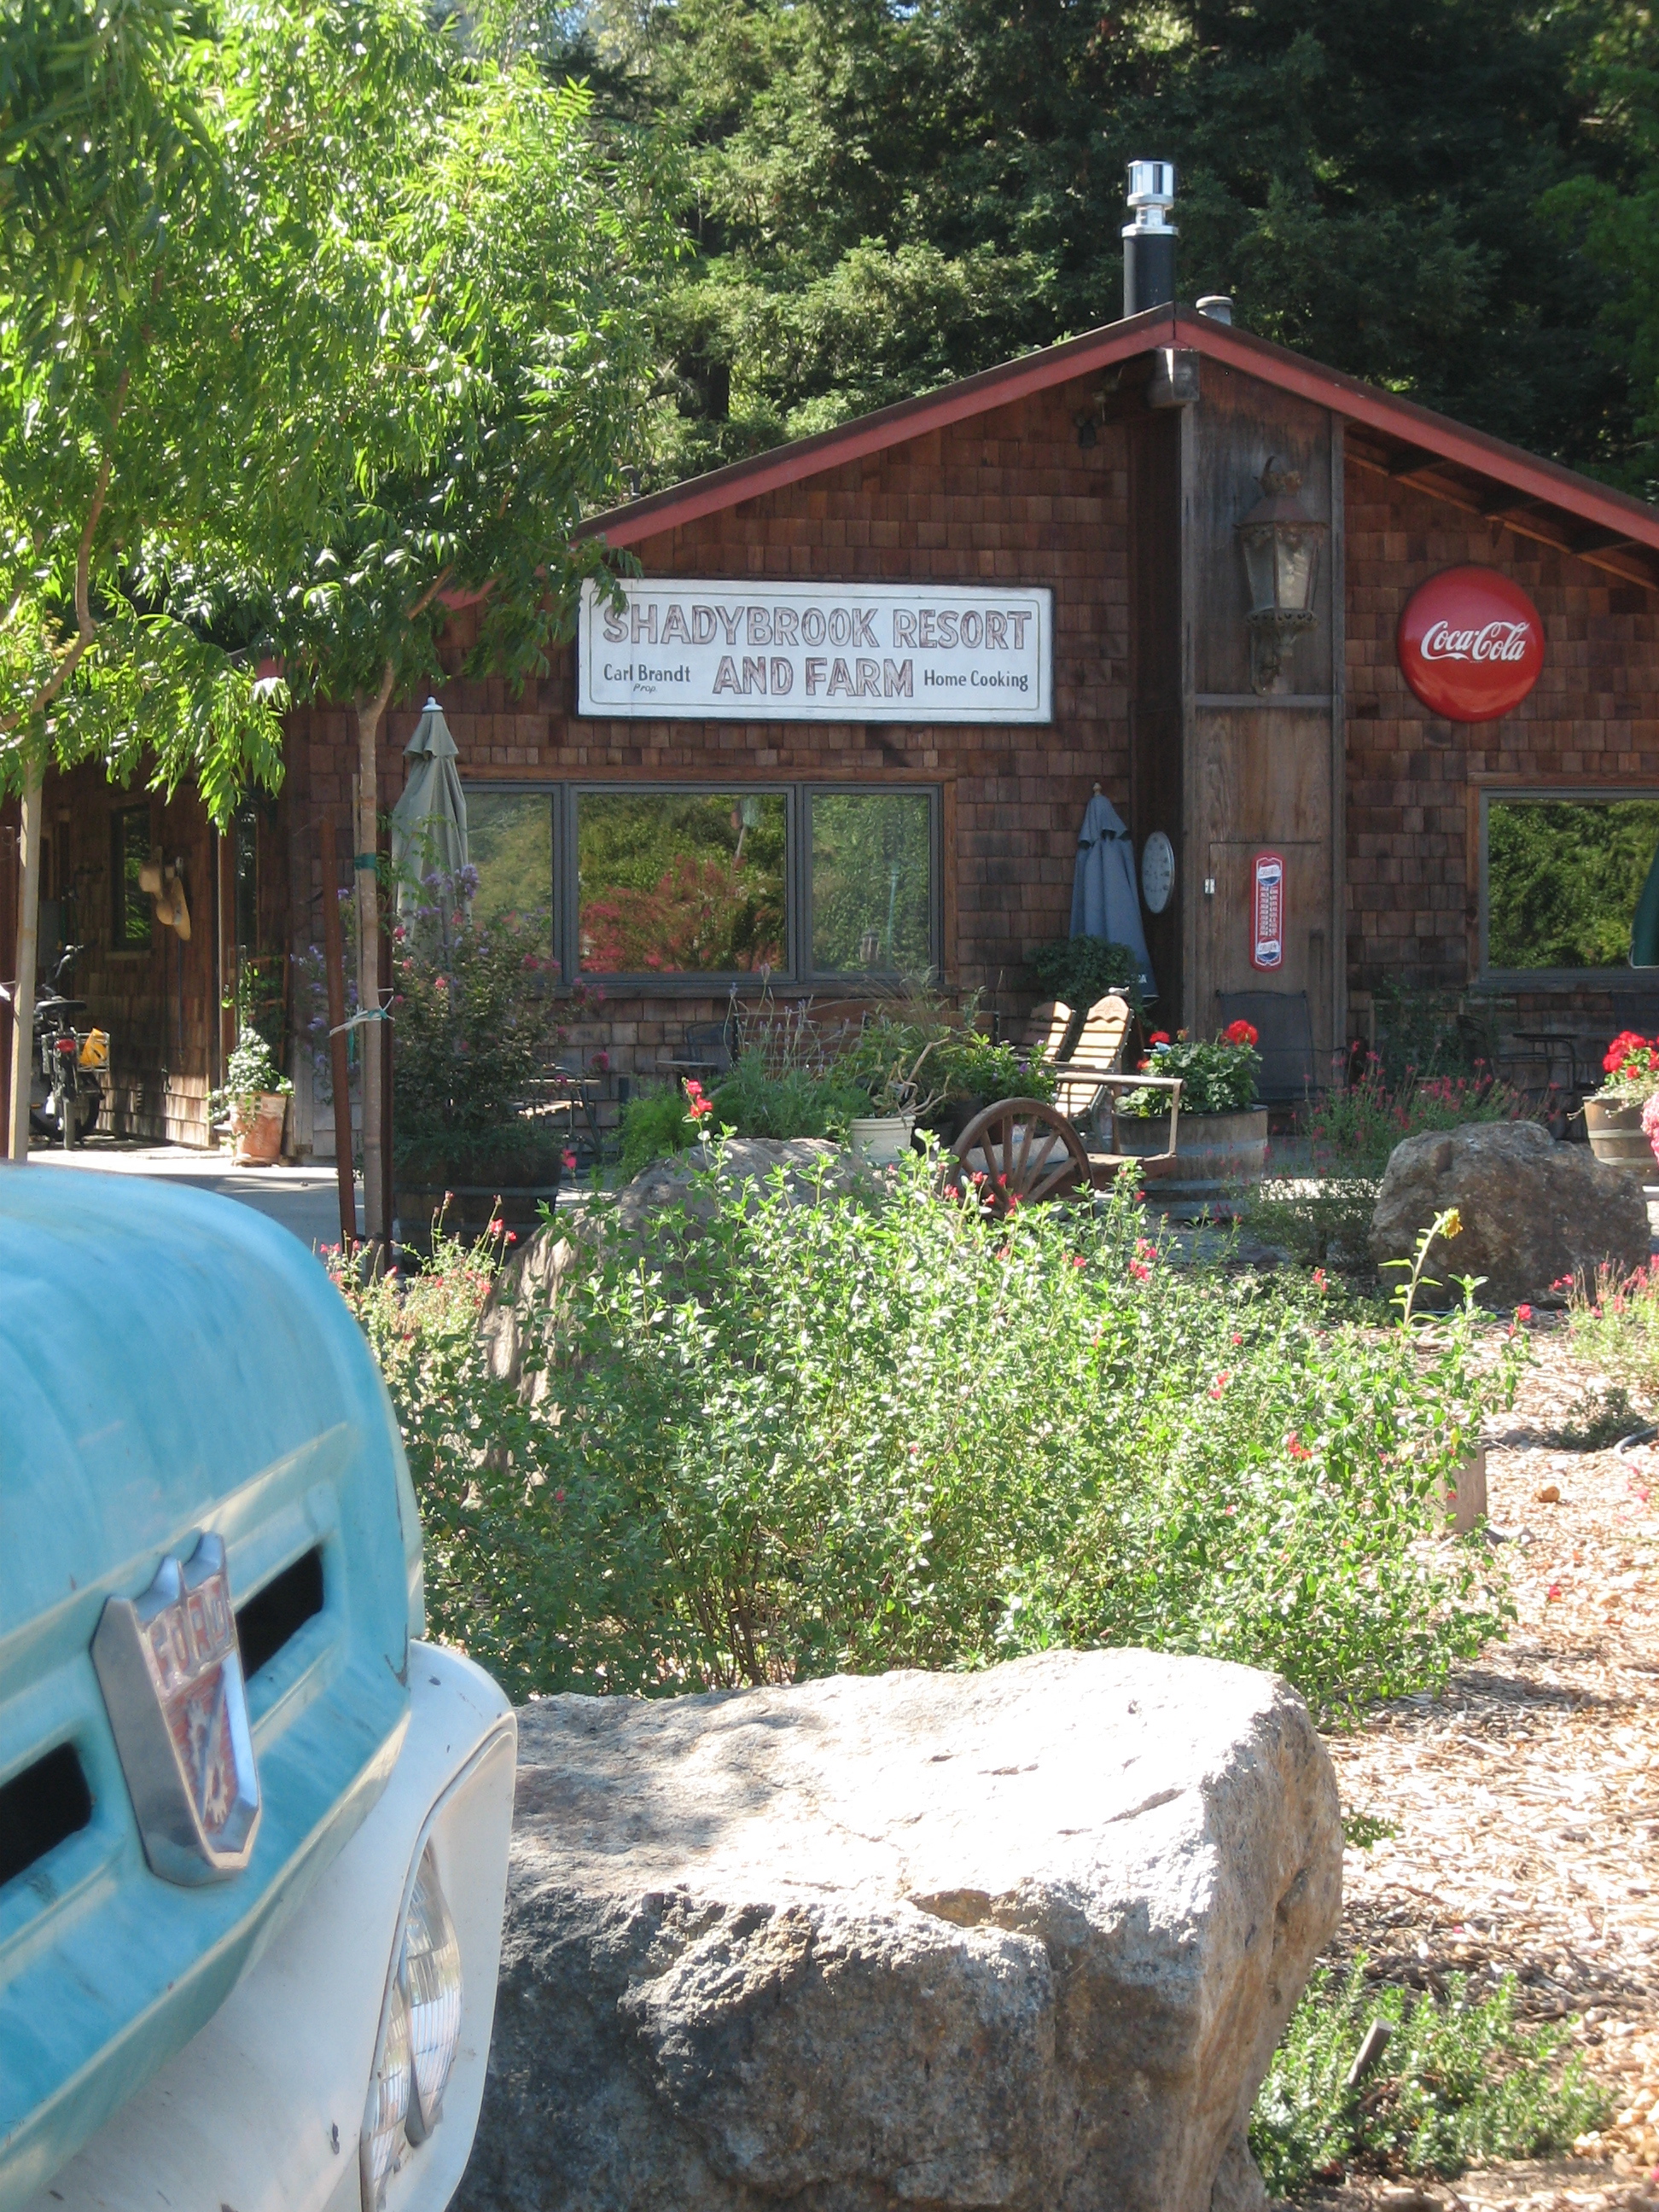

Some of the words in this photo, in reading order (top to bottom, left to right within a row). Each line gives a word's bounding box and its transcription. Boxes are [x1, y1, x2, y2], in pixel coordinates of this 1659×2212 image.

[602, 604, 880, 648] SHADYBROOK
[893, 608, 1032, 650] RESORT
[603, 663, 633, 681] Carl
[637, 664, 690, 683] Brandt
[712, 655, 795, 695] AND
[805, 657, 914, 697] FARM
[923, 669, 967, 687] Home
[970, 670, 1028, 692] Cooking
[147, 1579, 233, 1691] FORD
